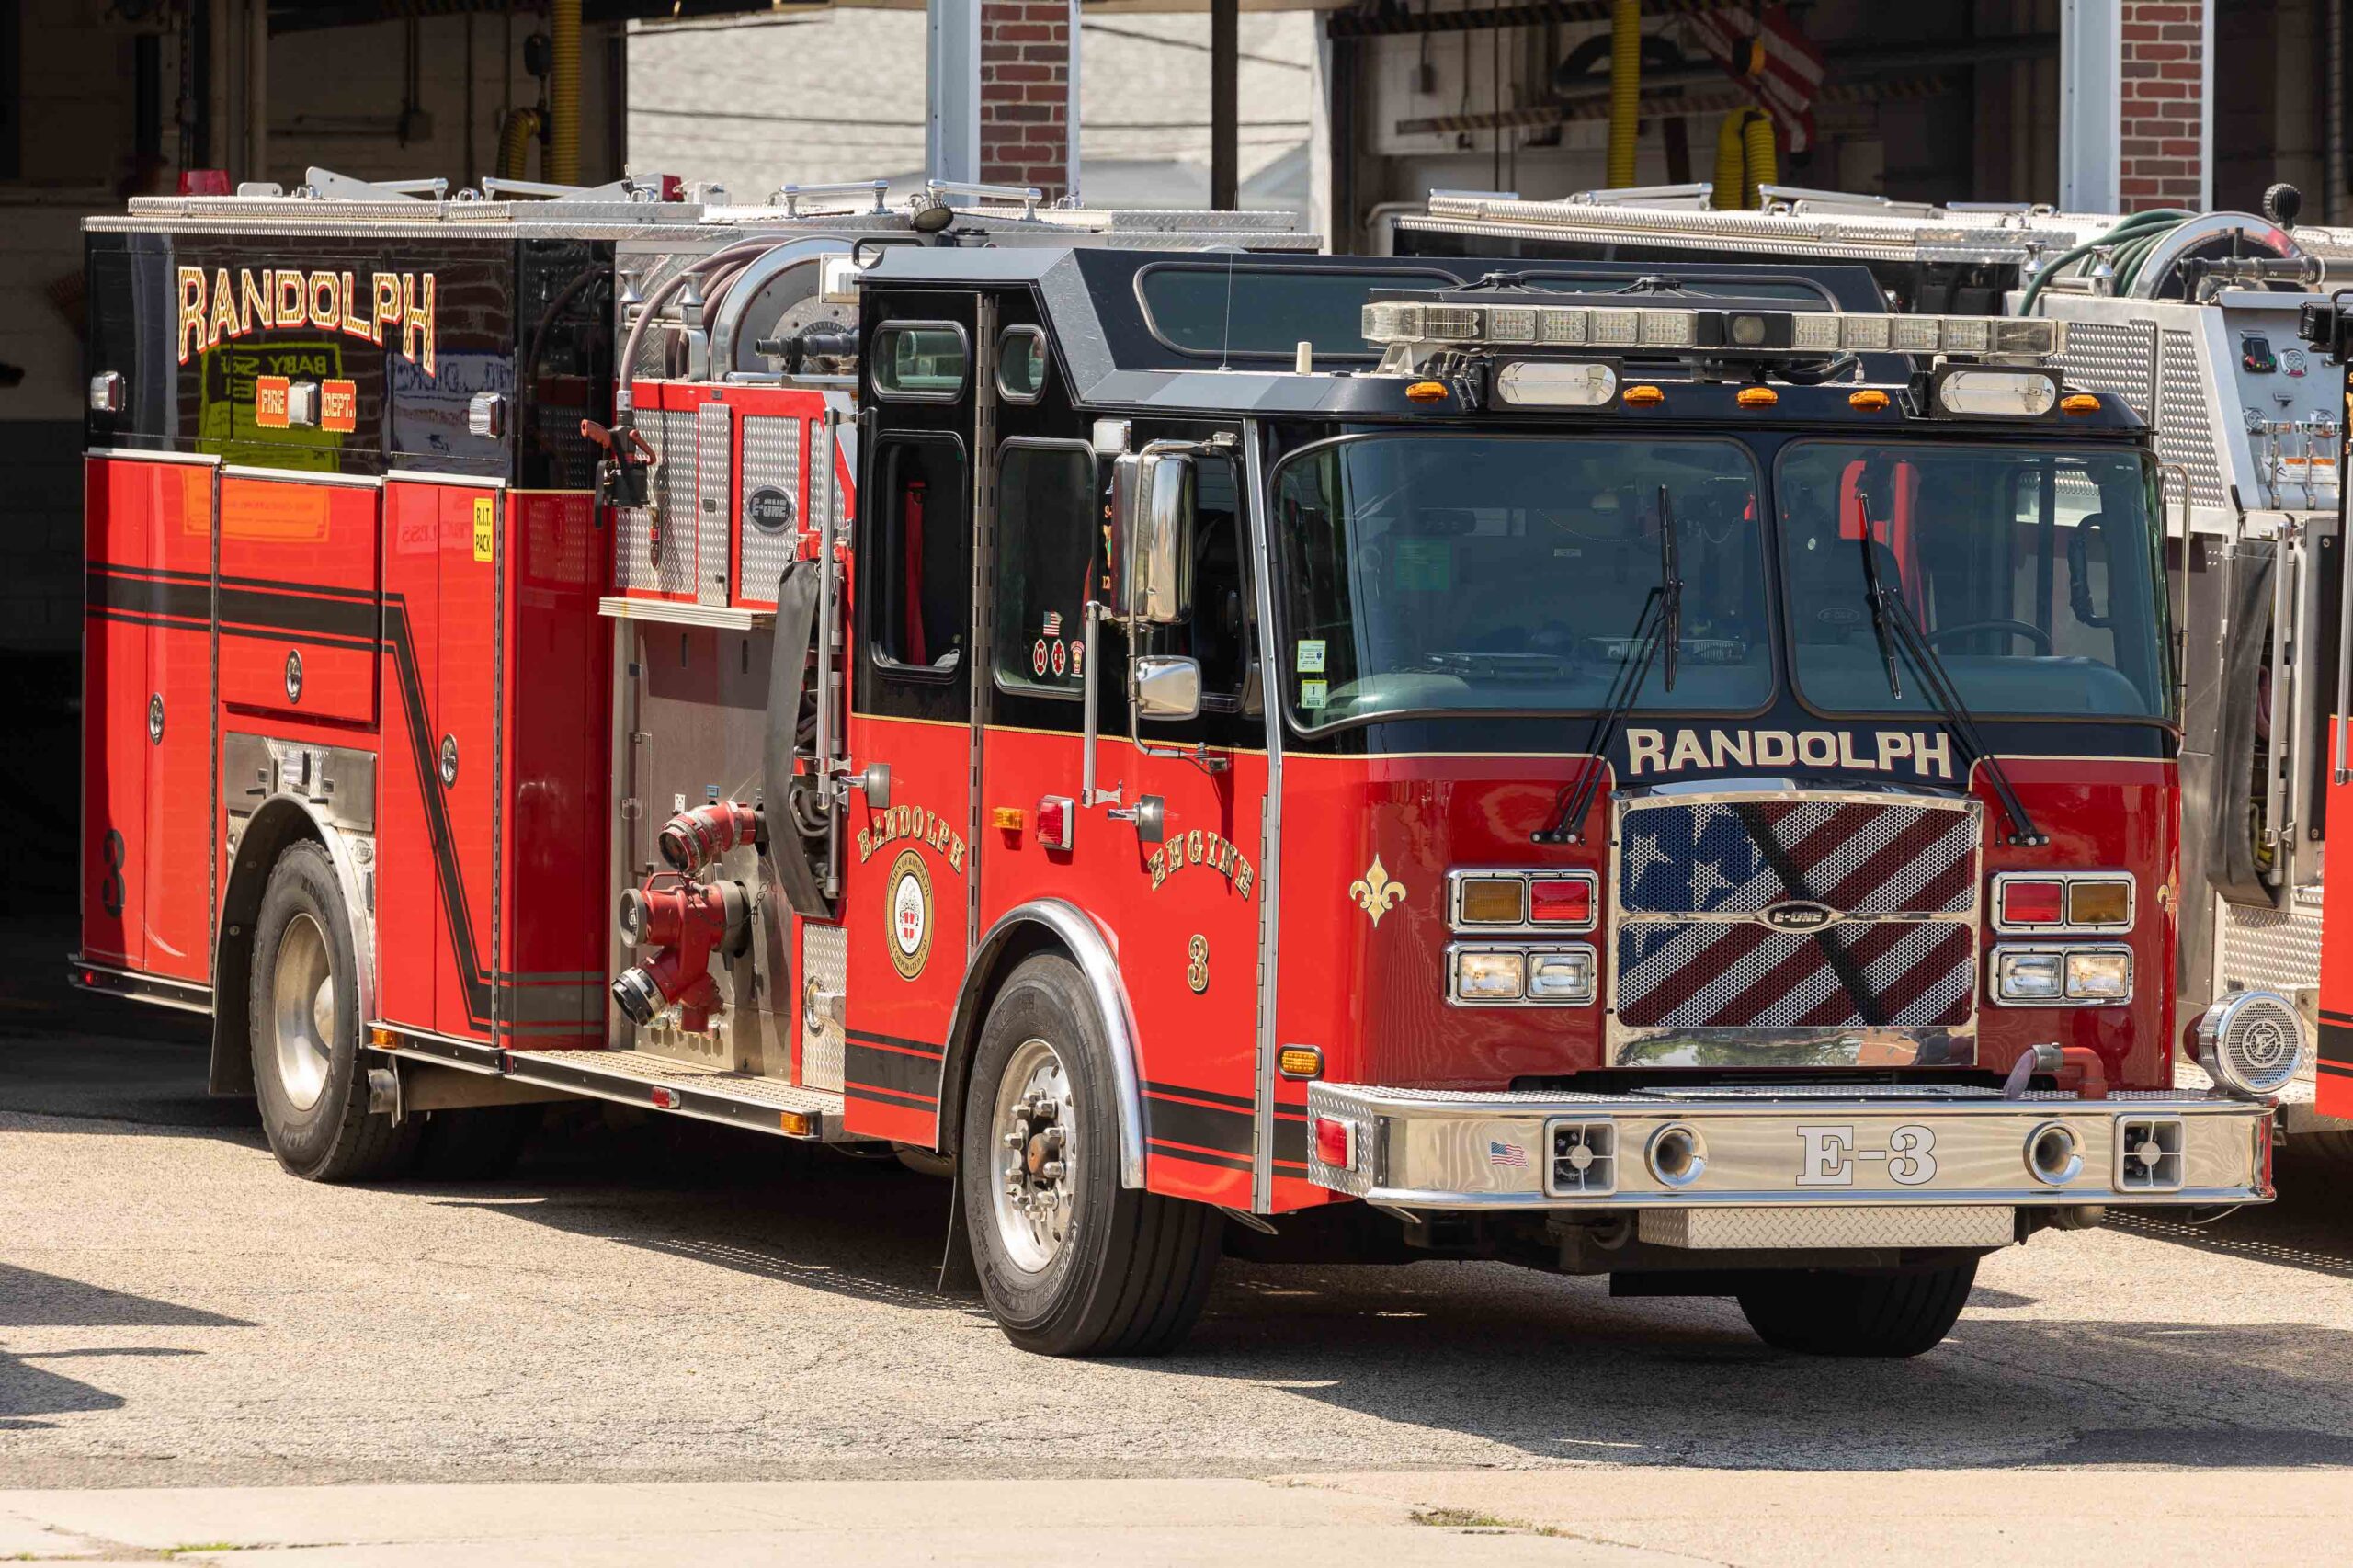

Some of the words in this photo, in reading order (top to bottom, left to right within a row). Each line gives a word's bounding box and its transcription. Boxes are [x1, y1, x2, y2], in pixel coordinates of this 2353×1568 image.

[178, 266, 436, 378] RANDOLPH
[261, 389, 285, 415] FIRE
[324, 392, 353, 418] DEPT.
[475, 534, 491, 553] PACK
[476, 507, 491, 527] R.I.T.
[1626, 728, 1953, 778] RANDOLPH
[857, 805, 966, 874] RANDOLPH
[1147, 830, 1254, 901] ENGINE
[102, 829, 126, 918] 3
[1773, 911, 1823, 923] E-ONE
[1188, 934, 1210, 995] 3
[1795, 1124, 1938, 1187] E-3
